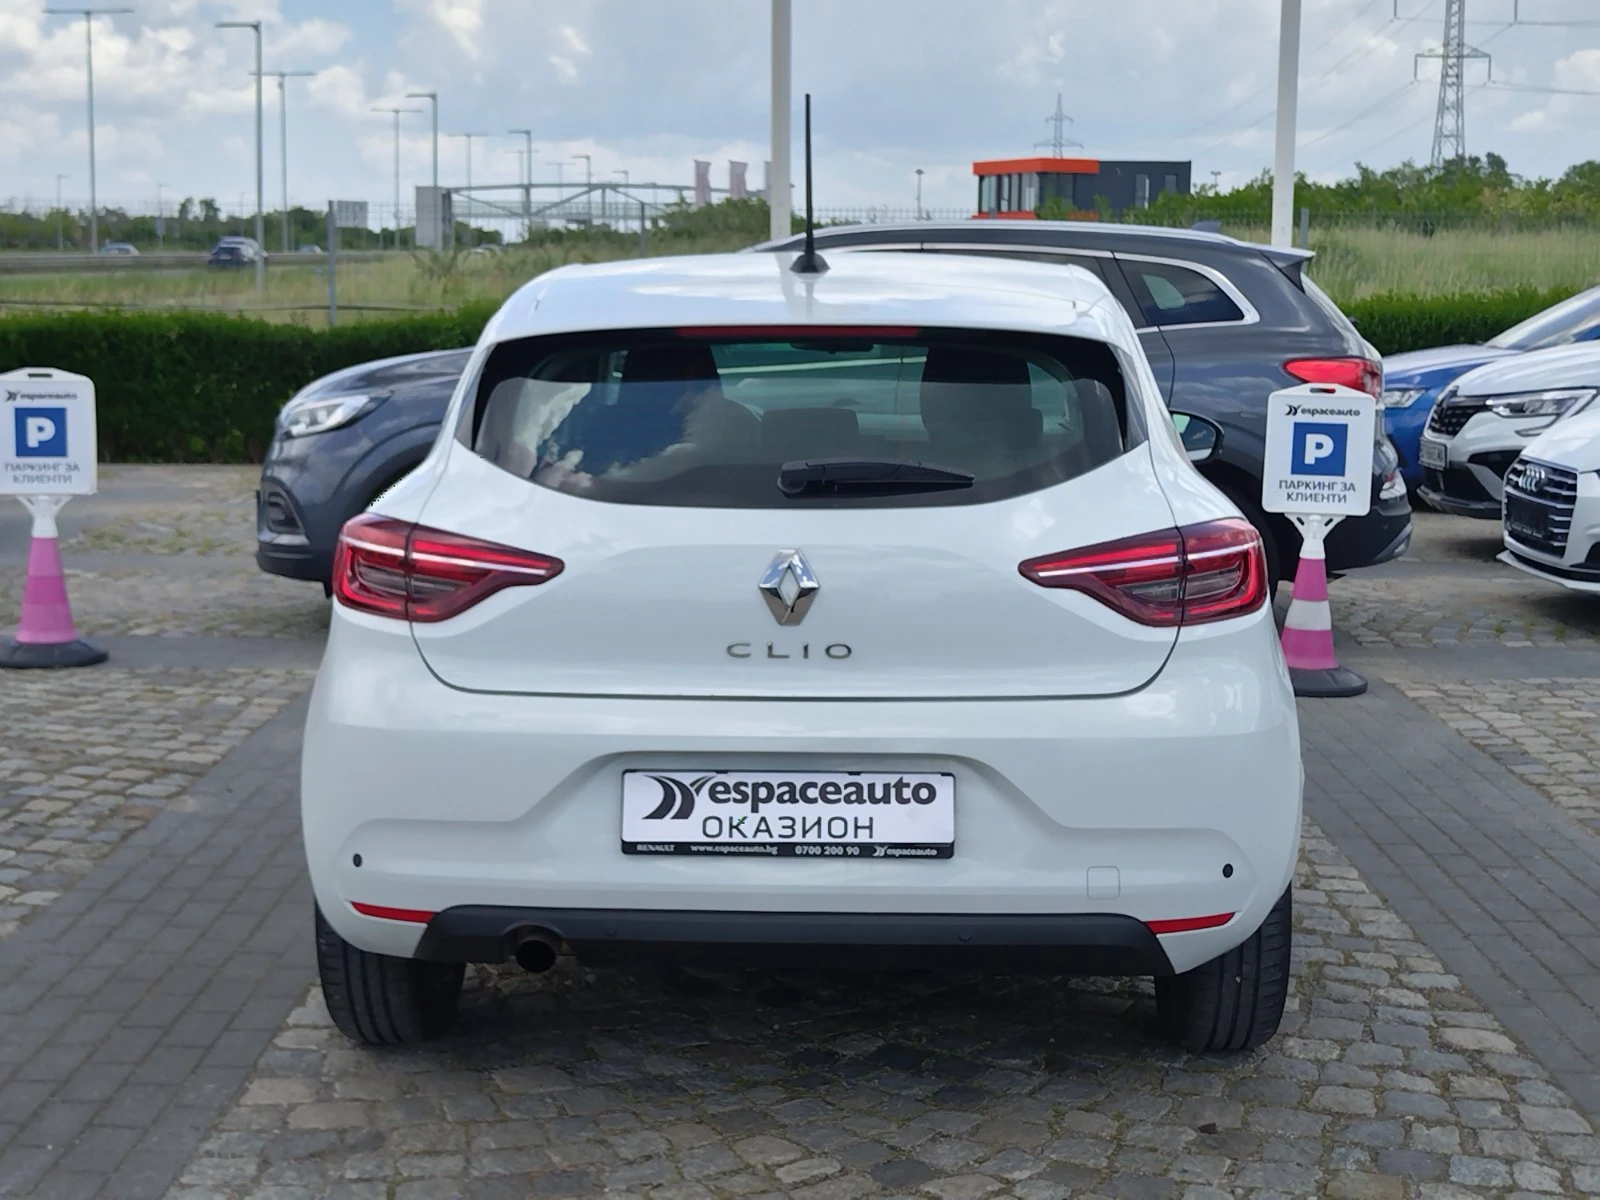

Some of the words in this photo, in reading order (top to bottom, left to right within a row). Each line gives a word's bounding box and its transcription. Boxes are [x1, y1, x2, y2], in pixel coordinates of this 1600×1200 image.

[1301, 406, 1361, 417] espaceauto
[27, 416, 55, 448] P
[1304, 433, 1334, 465] P
[65, 463, 80, 472] ЗА
[1279, 480, 1338, 491] ПАРКИНГ
[1340, 482, 1356, 492] ЗА
[1286, 493, 1347, 503] КЛИЕНТИ
[726, 642, 852, 659] CLIO
[708, 776, 937, 813] espaceauto
[702, 815, 874, 839] ОКАЗИОН
[795, 845, 821, 855] 0700
[824, 846, 843, 856] 200
[846, 846, 860, 856] 90
